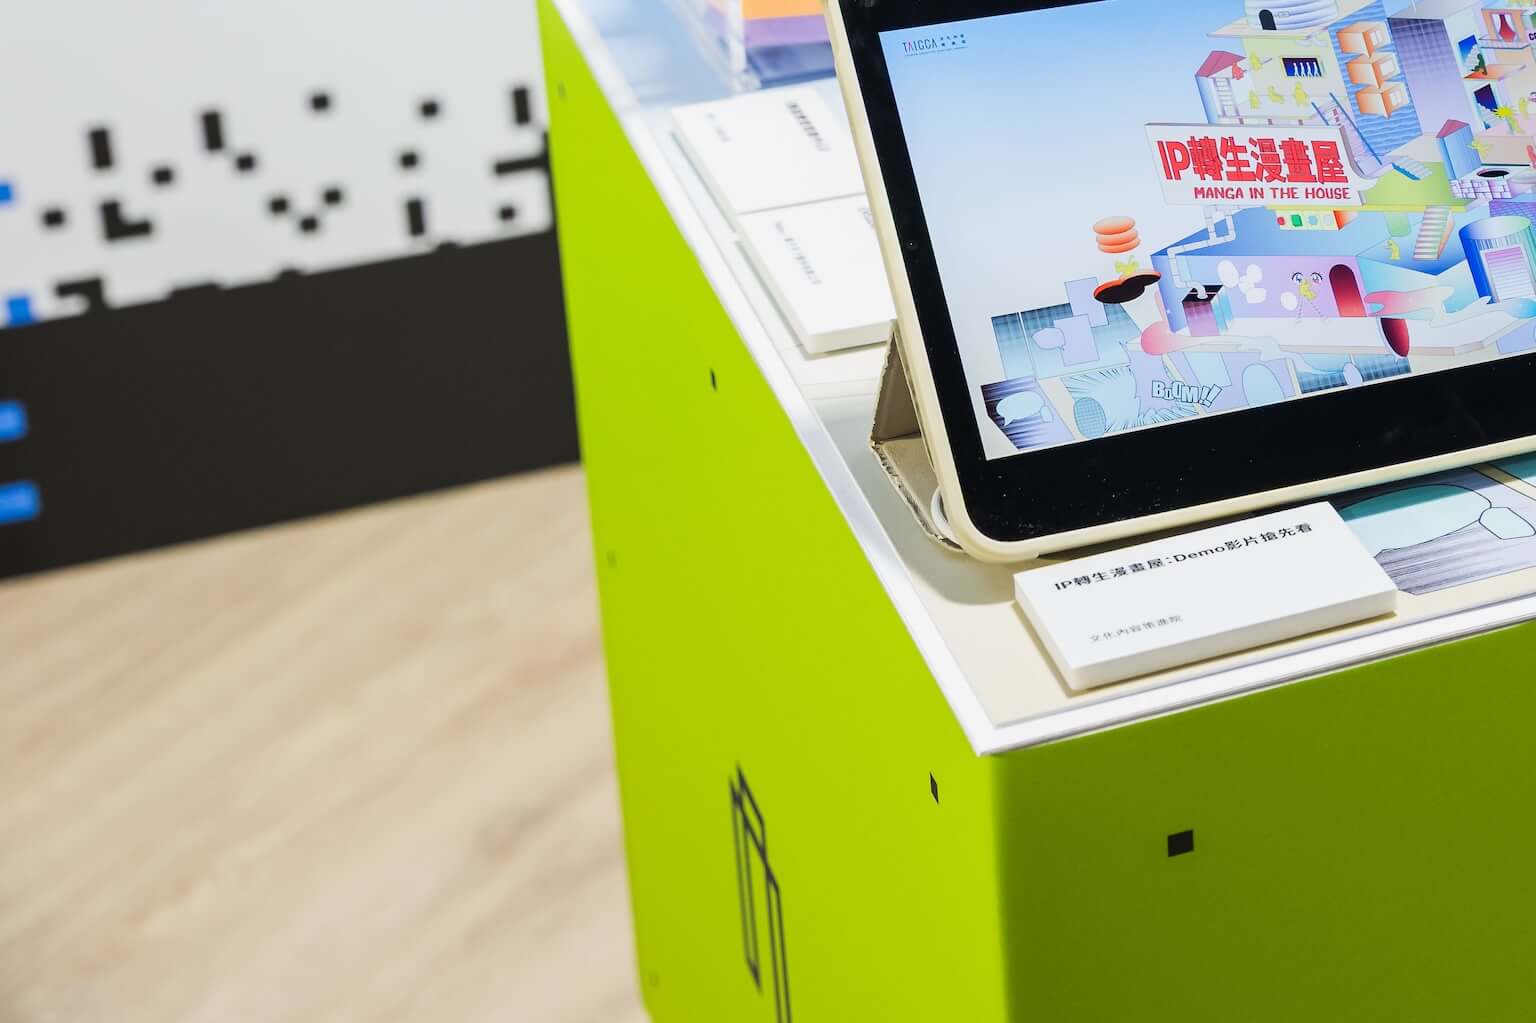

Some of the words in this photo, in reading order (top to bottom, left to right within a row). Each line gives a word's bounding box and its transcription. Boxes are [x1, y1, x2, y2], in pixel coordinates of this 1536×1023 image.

[1156, 135, 1349, 184] IP轉生漫畫屋
[1194, 187, 1244, 200] MANGA
[1249, 187, 1265, 200] IN
[1271, 187, 1300, 200] THE
[1305, 187, 1351, 200] HOUSE
